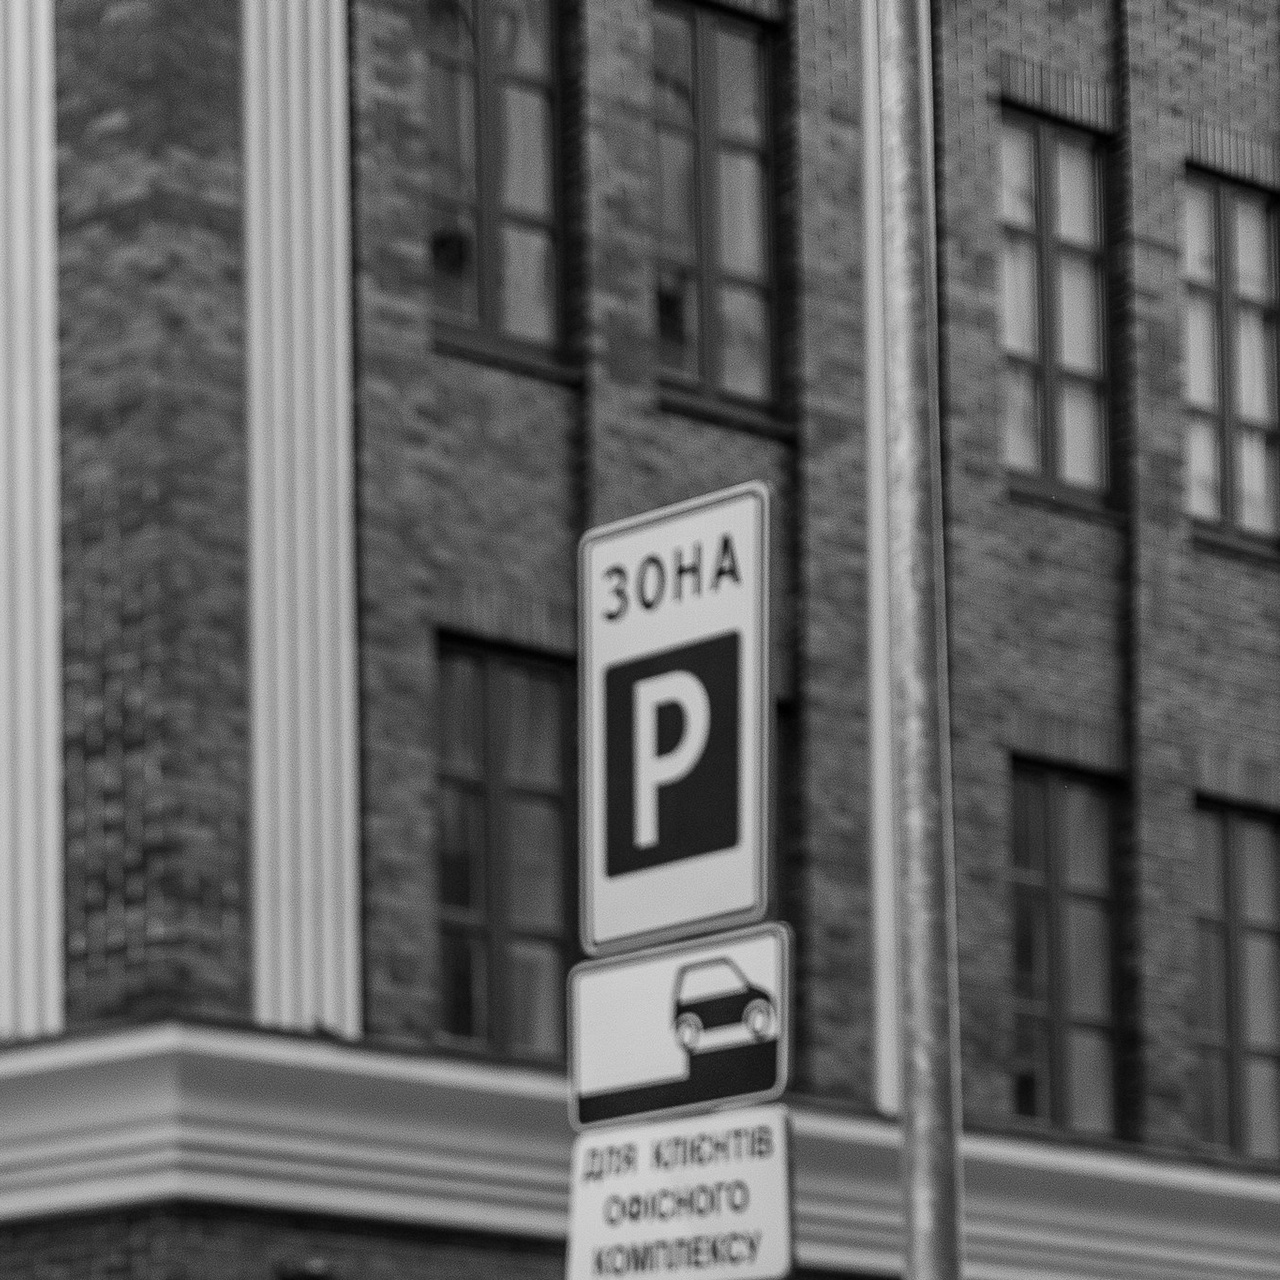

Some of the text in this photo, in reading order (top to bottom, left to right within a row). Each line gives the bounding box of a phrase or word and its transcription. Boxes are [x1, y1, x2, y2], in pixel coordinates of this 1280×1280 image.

[603, 532, 742, 622] ЗОНА
[631, 669, 712, 850] P
[583, 1142, 638, 1182] ДЛЯ
[602, 1179, 751, 1227] ОФІСНОГО
[592, 1230, 763, 1277] КОМПЛЕКСУ
